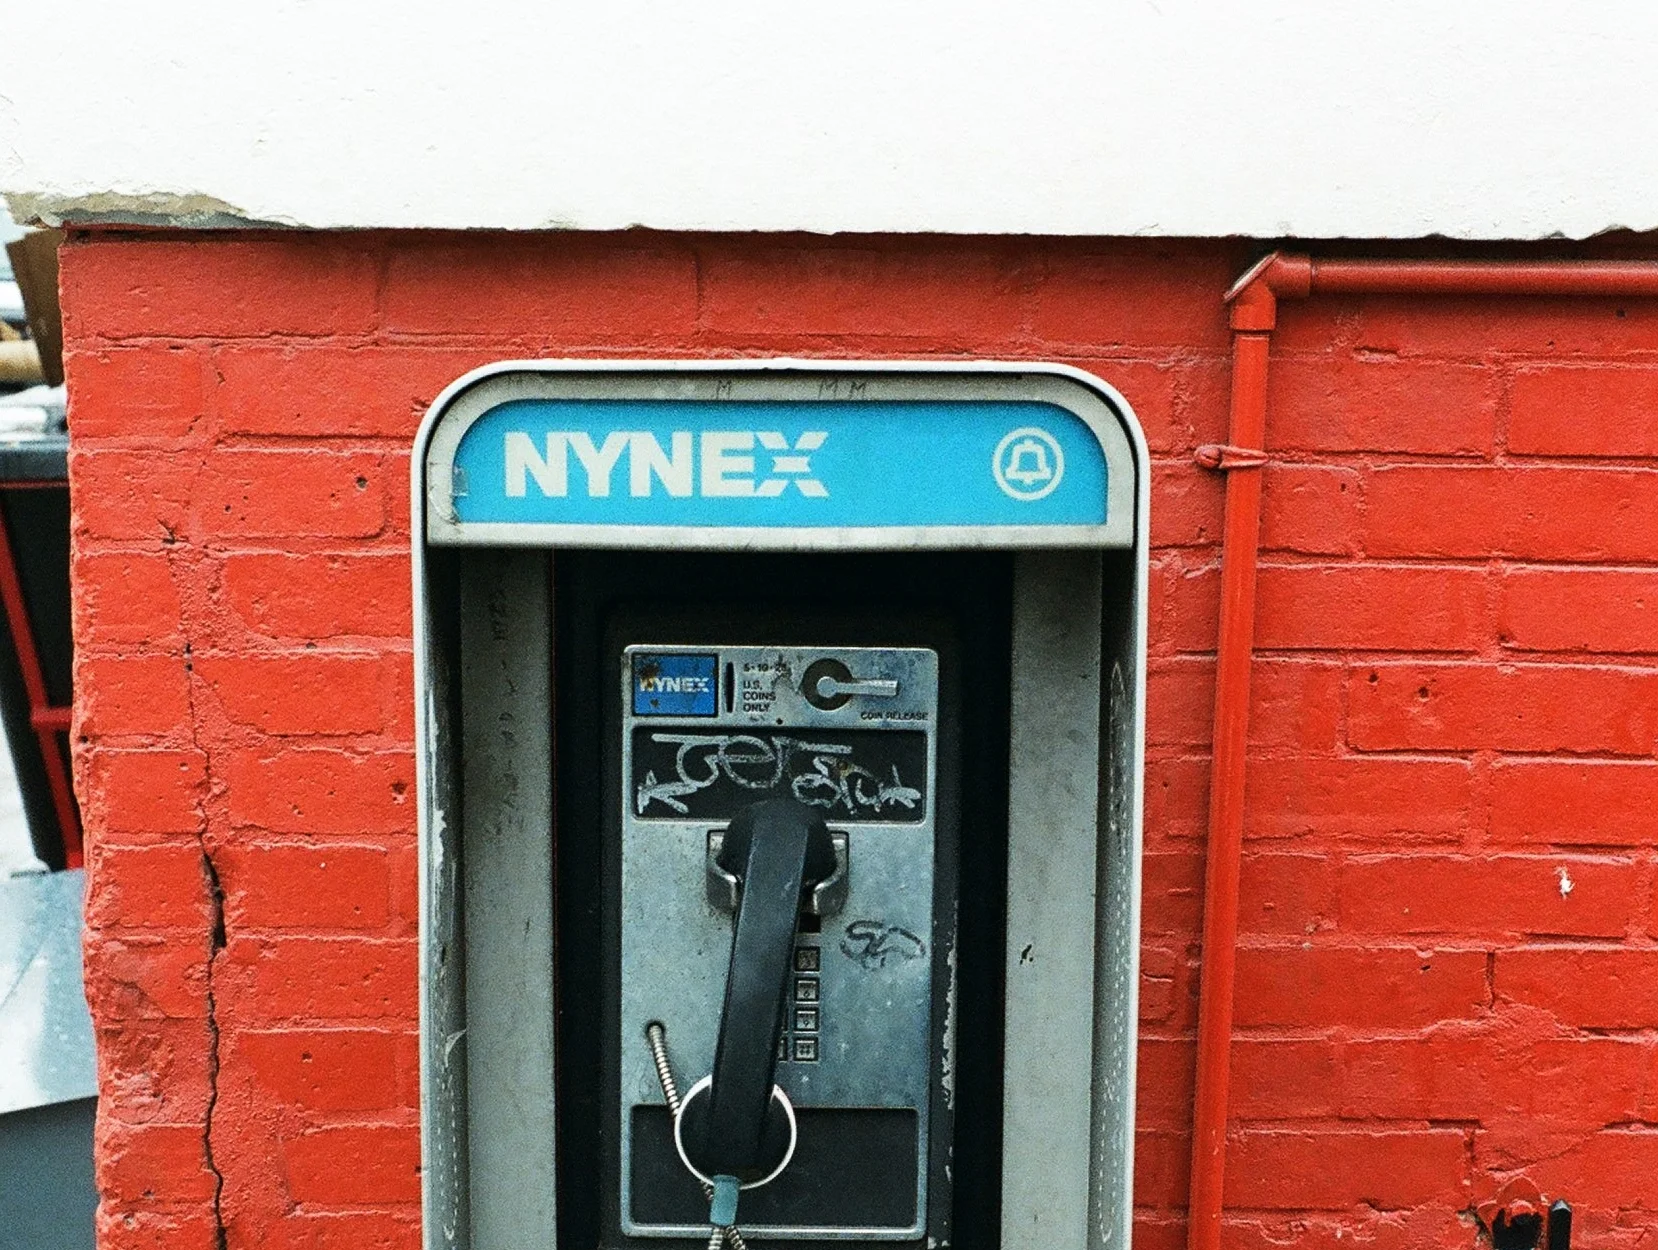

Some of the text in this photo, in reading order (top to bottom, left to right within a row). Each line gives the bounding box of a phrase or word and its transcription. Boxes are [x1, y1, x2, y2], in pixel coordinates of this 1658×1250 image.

[505, 430, 829, 498] NYNEX
[743, 691, 776, 701] COINS
[743, 703, 770, 712] ONLY
[860, 711, 883, 720] COIN
